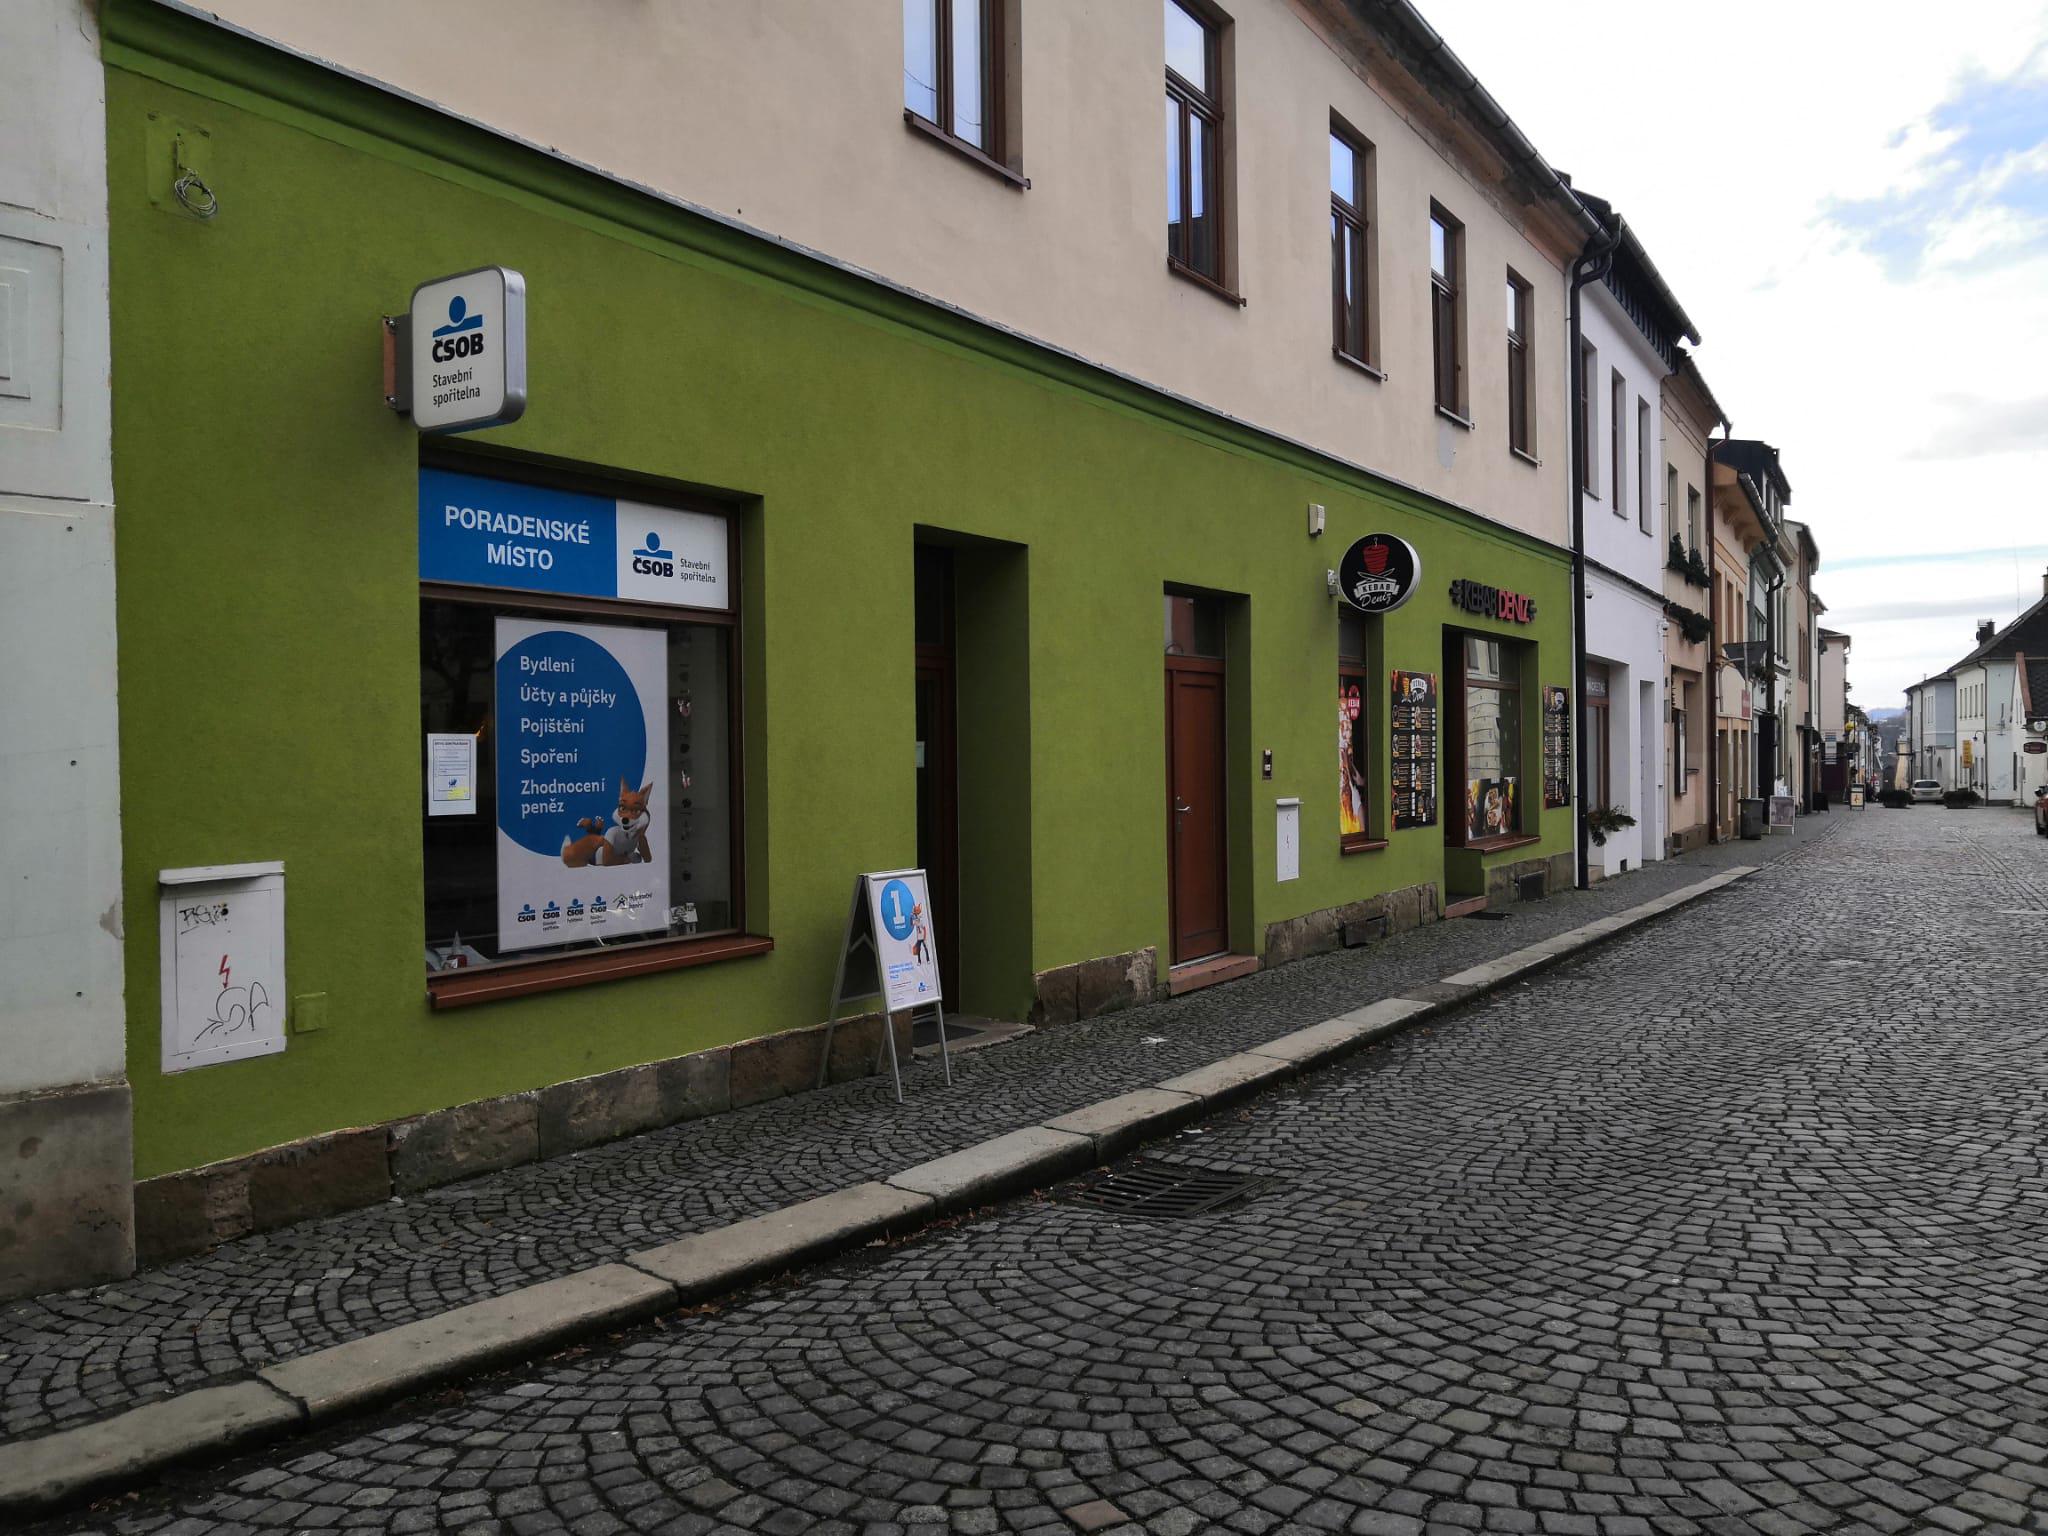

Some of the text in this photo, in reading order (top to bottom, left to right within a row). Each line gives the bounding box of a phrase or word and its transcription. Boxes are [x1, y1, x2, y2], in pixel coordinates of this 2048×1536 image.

[432, 333, 484, 363] ČSOB
[432, 366, 473, 388] Stavební
[432, 385, 481, 408] spořitelna
[445, 504, 591, 545] PORADENSKÉ
[487, 540, 554, 571] MÍSTO
[680, 558, 711, 571] Stavební
[632, 556, 674, 578] ČSOB
[680, 570, 716, 584] spořitelna
[1362, 583, 1392, 593] KEBAB
[1359, 591, 1392, 608] Deniz
[1463, 579, 1530, 623] KEBAB DENIZ
[520, 655, 576, 676] Bydlení
[520, 682, 617, 709] Účty a půjčky
[520, 717, 585, 738] Pojištění
[520, 747, 578, 769] Spoření
[520, 779, 606, 796] Zhodnocení
[521, 798, 565, 820] peněz
